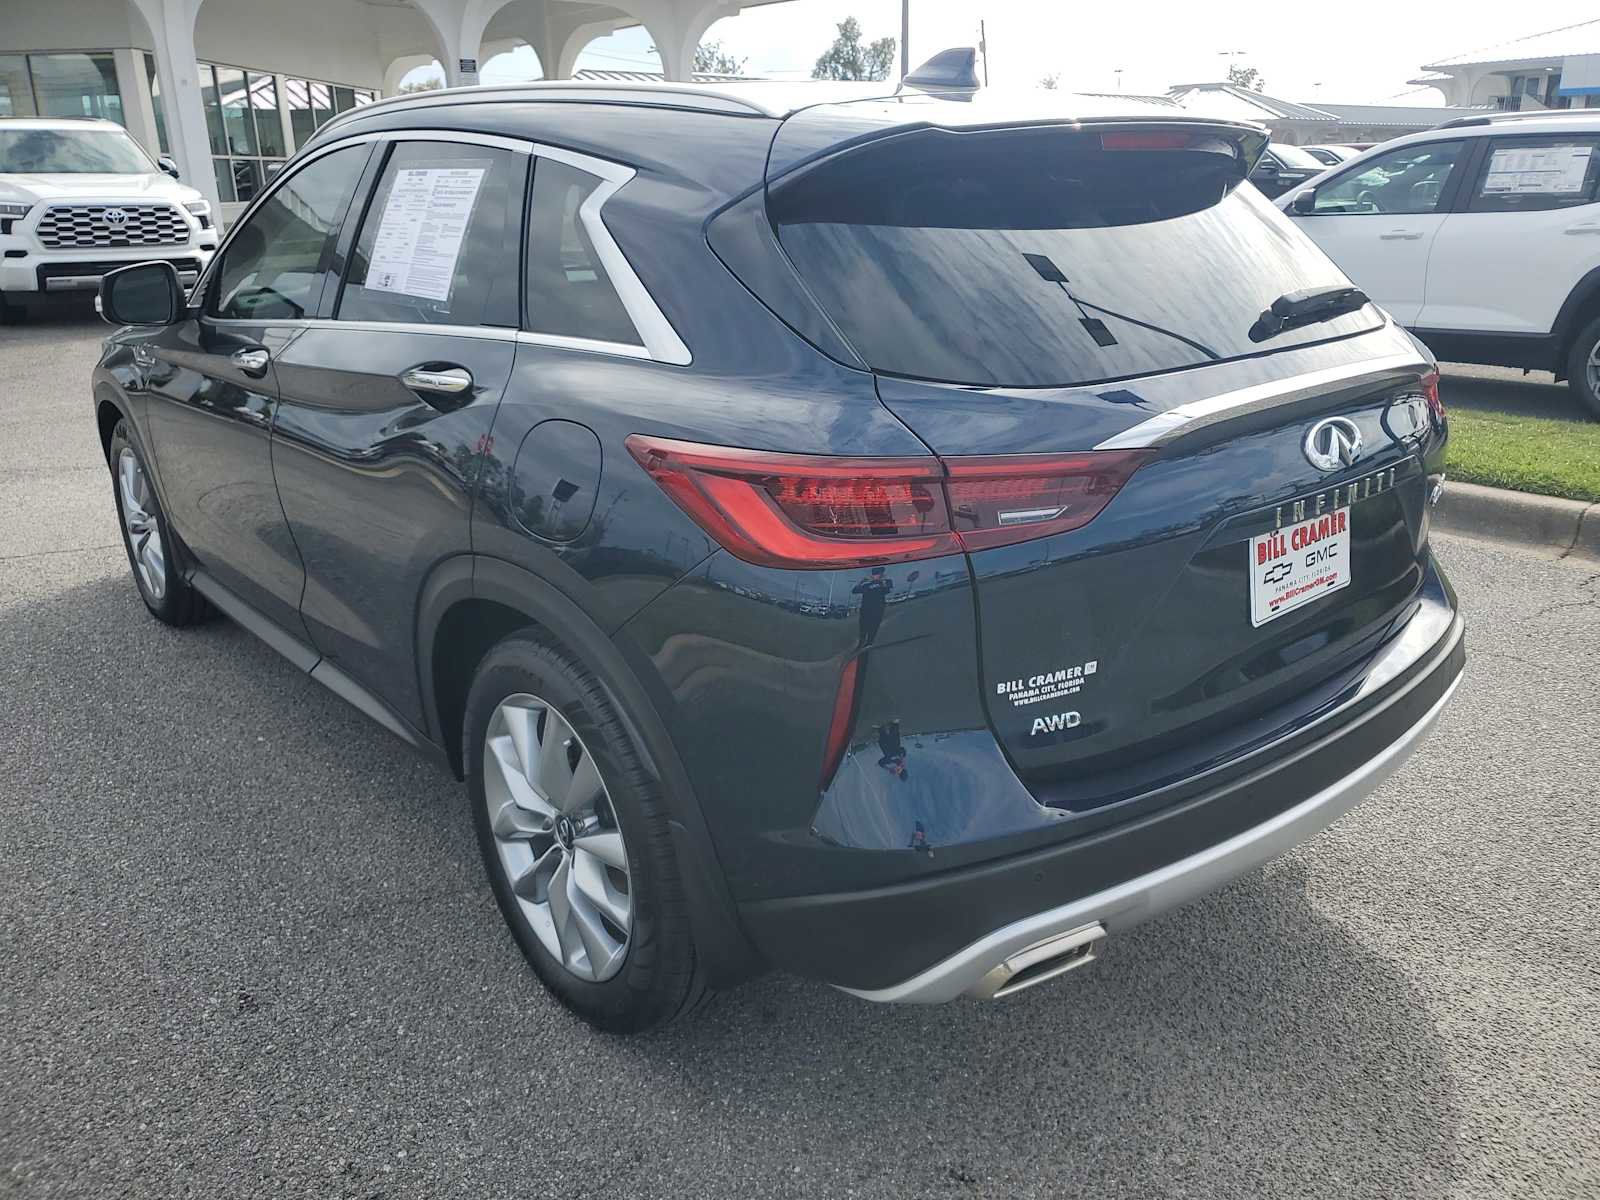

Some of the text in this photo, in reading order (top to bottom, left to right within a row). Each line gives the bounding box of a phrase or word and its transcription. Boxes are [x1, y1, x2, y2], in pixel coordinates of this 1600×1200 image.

[1276, 468, 1396, 528] INFINITI
[1257, 511, 1347, 566] BILL CRAMER
[1305, 543, 1338, 567] GMC
[1276, 581, 1297, 593] PANAMA
[1312, 565, 1331, 578] FLORIDA
[996, 679, 1025, 695] BILL
[1028, 666, 1083, 688] CRAMER
[1009, 678, 1085, 701] PANAMA CITY, FLORIDA
[1031, 711, 1081, 736] AWD
